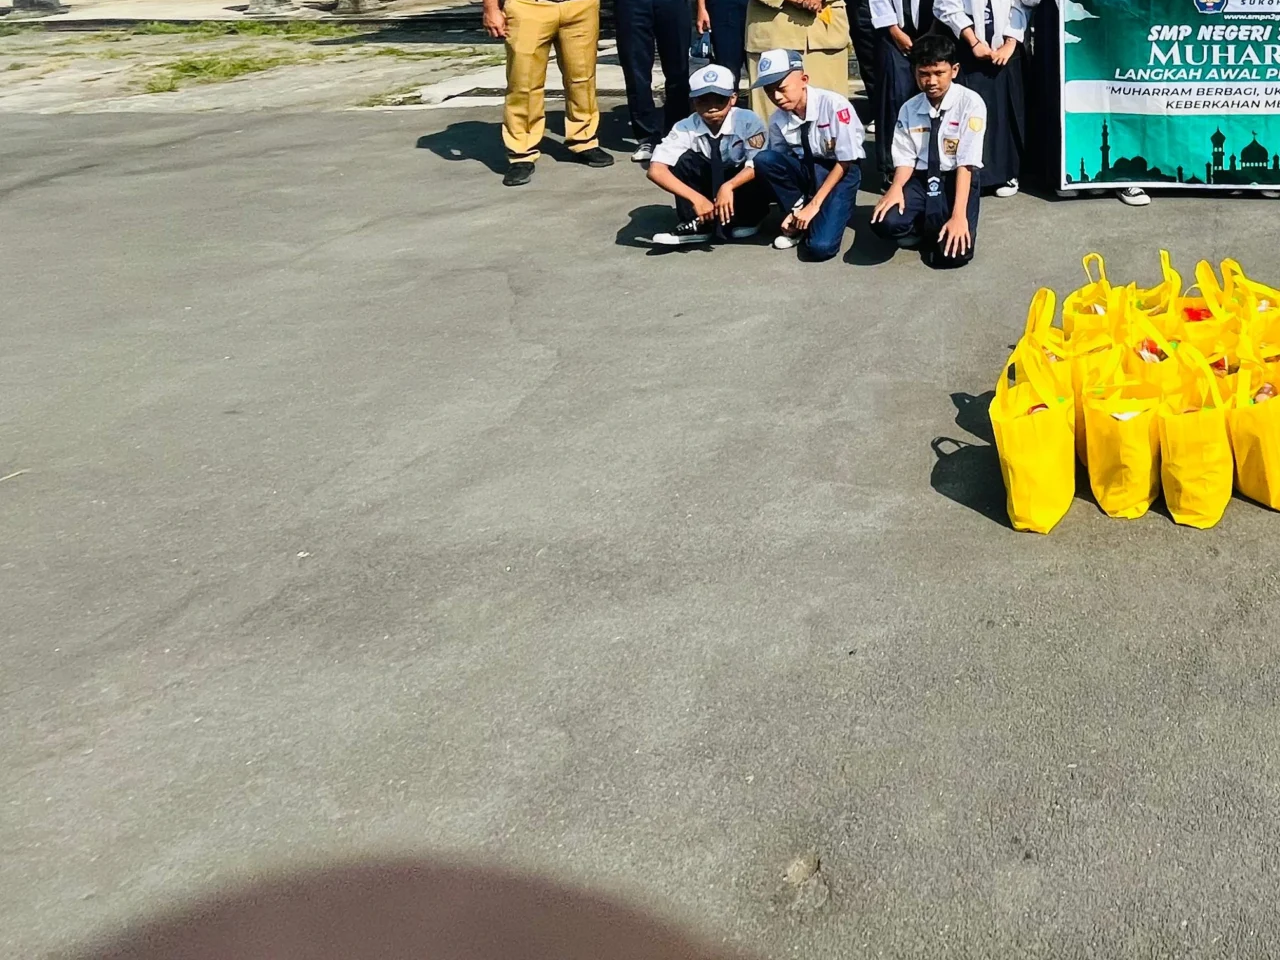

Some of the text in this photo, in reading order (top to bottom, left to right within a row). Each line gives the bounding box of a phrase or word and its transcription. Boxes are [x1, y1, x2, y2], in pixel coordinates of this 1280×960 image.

[1148, 25, 1192, 41] SMP
[1197, 25, 1272, 42] NEGERI
[1115, 68, 1200, 80] LANGKAH
[1205, 68, 1260, 80] AWAL
[1196, 87, 1260, 97] BERBAGI,
[1166, 100, 1260, 109] KEBERKAHAN
